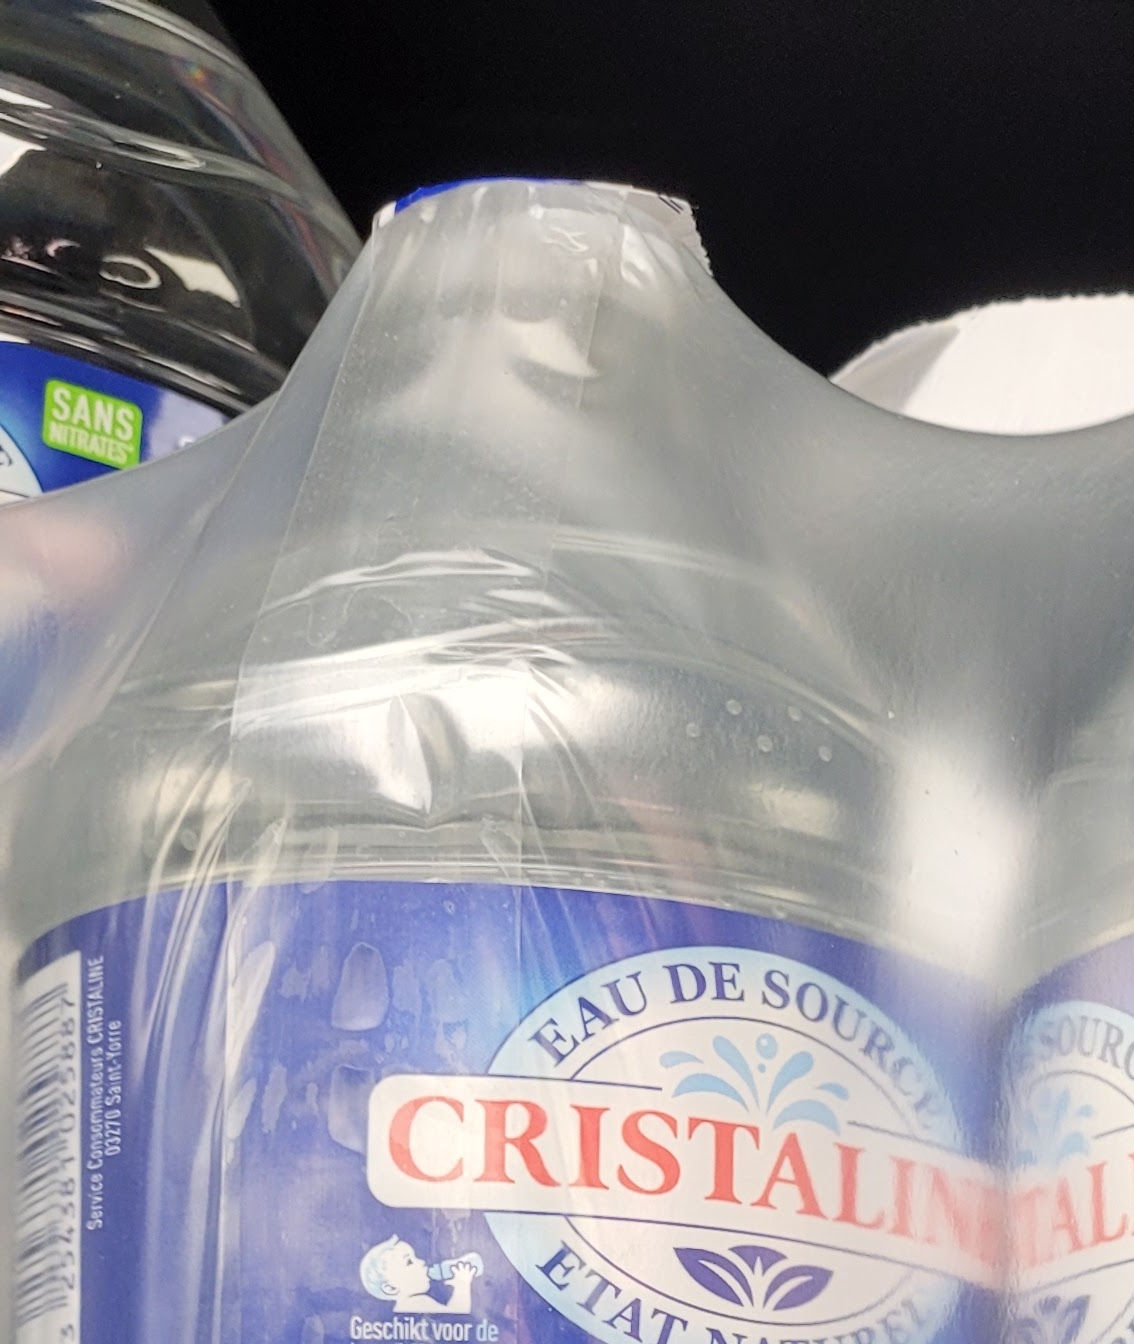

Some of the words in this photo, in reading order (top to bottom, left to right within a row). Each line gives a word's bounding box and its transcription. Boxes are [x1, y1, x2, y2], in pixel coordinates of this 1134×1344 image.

[52, 387, 134, 441] SANS
[87, 956, 104, 1044] CRISTALINE
[527, 973, 651, 1068] EAU
[665, 961, 746, 1004] DE
[106, 1019, 122, 1107] Saint-Yorre
[87, 1045, 104, 1171] Consommateurs
[105, 1110, 121, 1156] 03270
[86, 1174, 103, 1230] Service
[350, 1315, 430, 1341] Geschikt
[432, 1322, 474, 1342] voor
[476, 1319, 500, 1343] de
